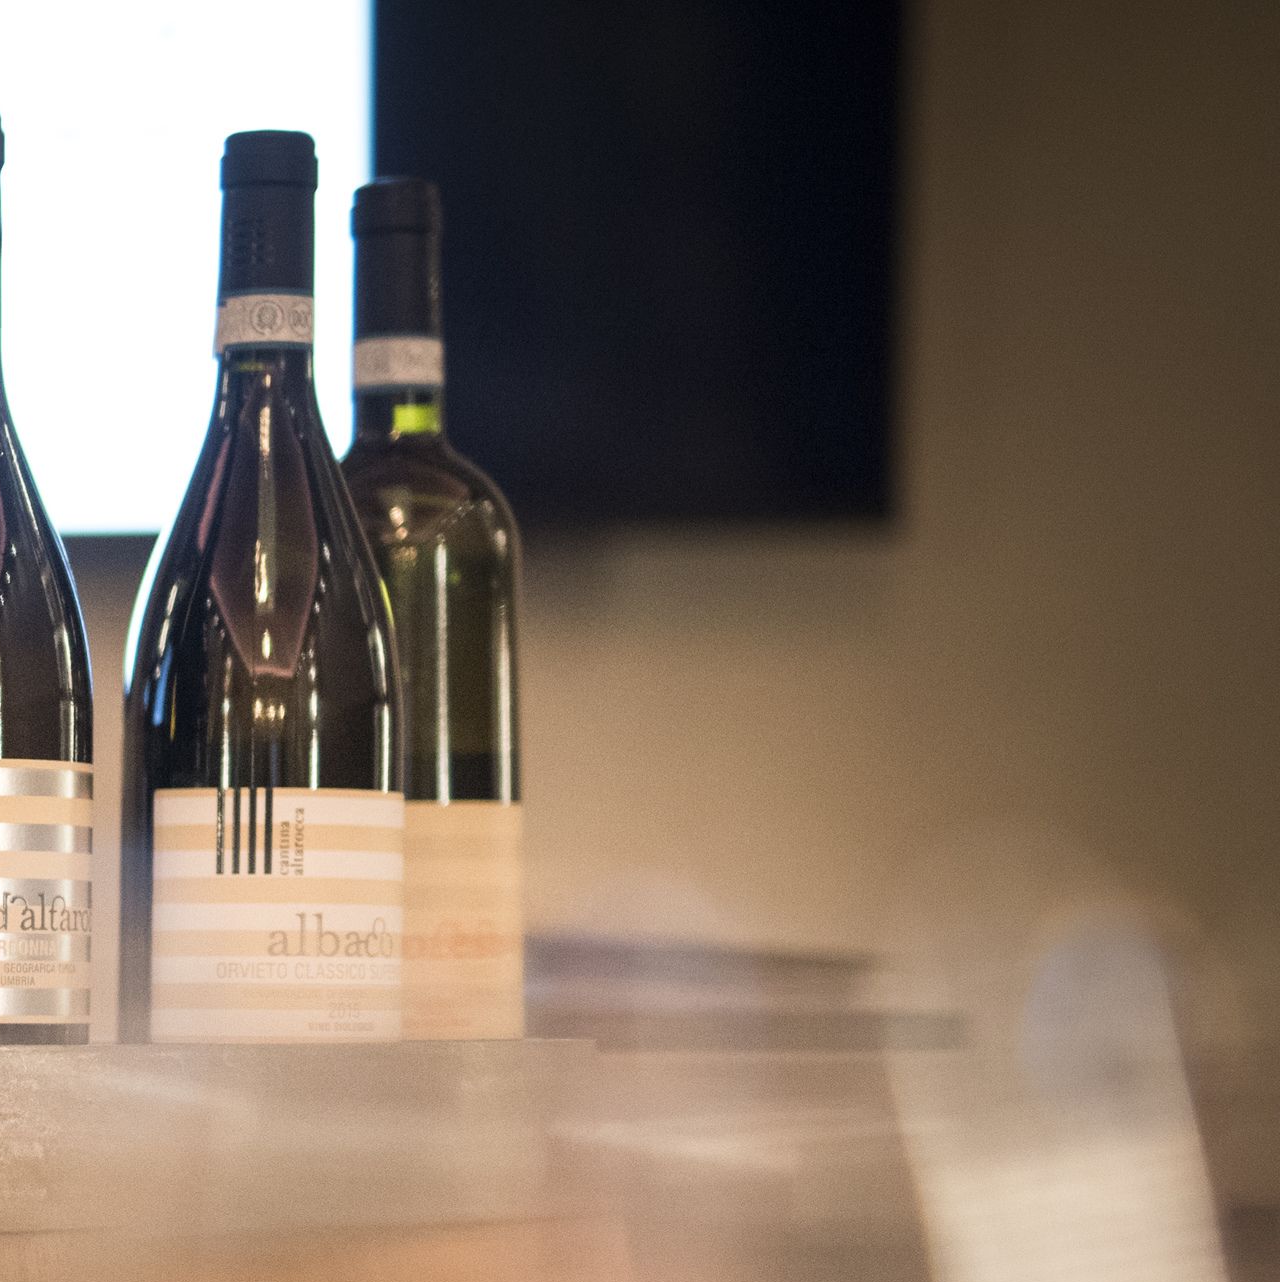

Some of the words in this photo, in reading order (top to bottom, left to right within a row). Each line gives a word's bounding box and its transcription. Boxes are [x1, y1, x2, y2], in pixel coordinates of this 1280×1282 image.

[215, 961, 289, 980] ORVIETO
[294, 962, 367, 980] CLASSICO
[0, 975, 36, 987] UMBRIA
